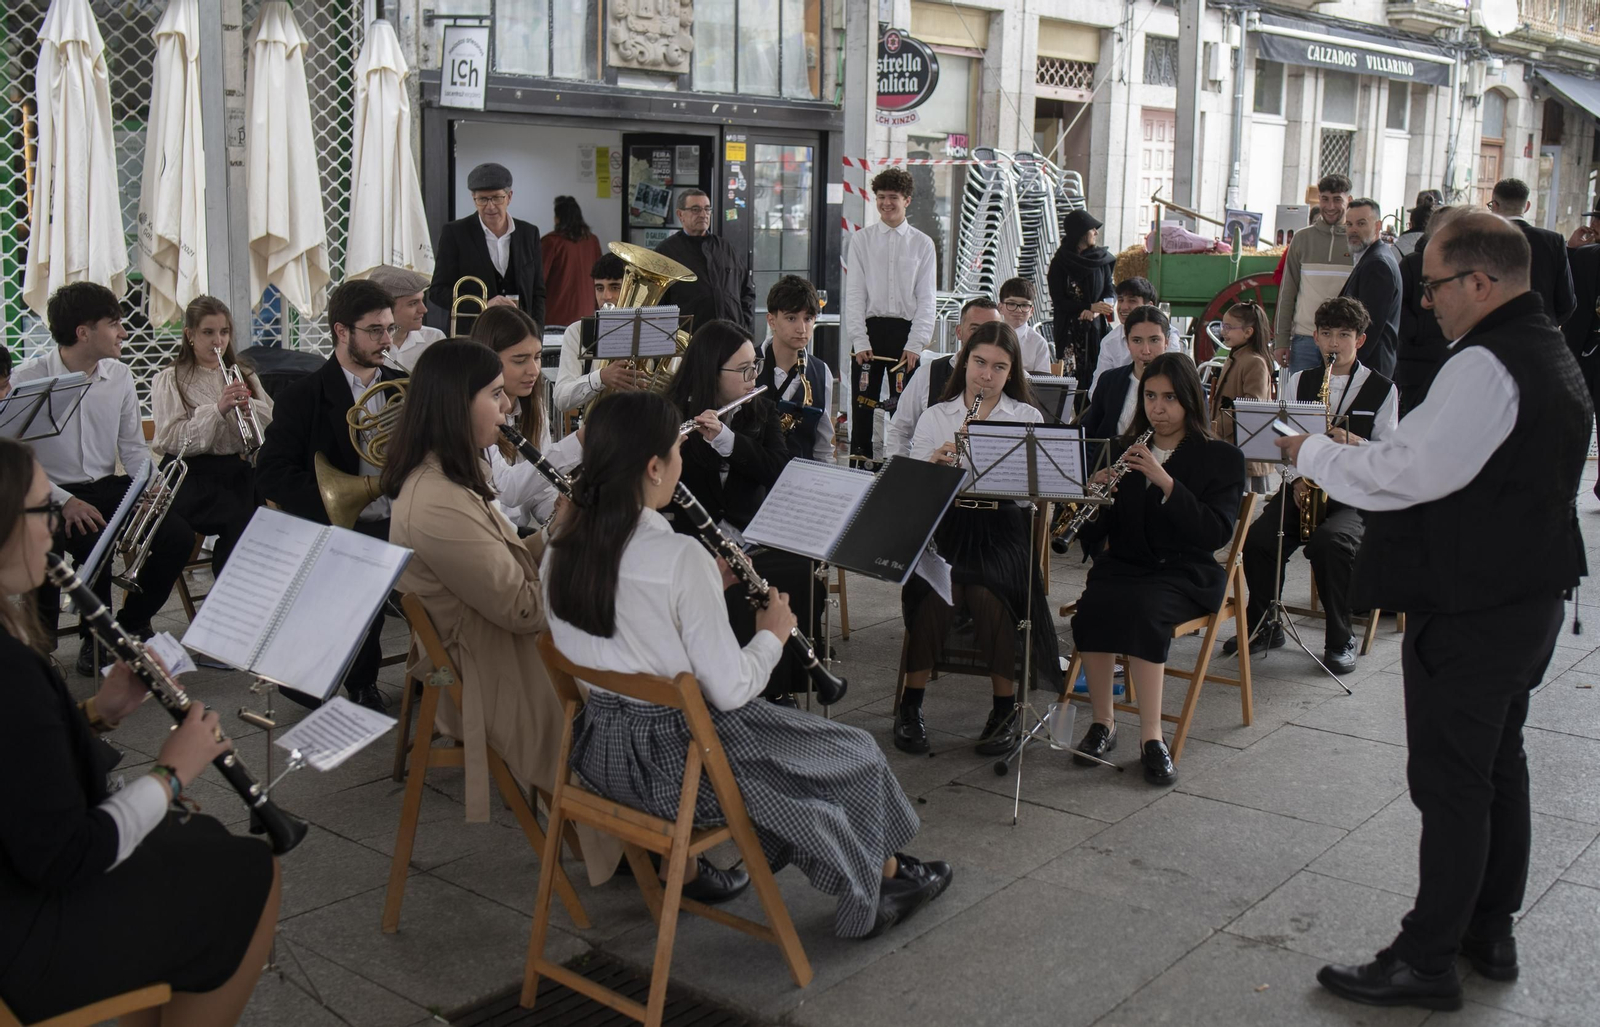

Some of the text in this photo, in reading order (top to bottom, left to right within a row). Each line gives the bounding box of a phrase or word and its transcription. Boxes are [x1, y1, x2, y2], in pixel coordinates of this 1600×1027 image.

[877, 53, 922, 73] strella
[1307, 45, 1414, 76] CALZADOS VILLARINO
[892, 113, 916, 125] XINZO
[946, 146, 968, 157] NON
[181, 243, 195, 257] 2021
